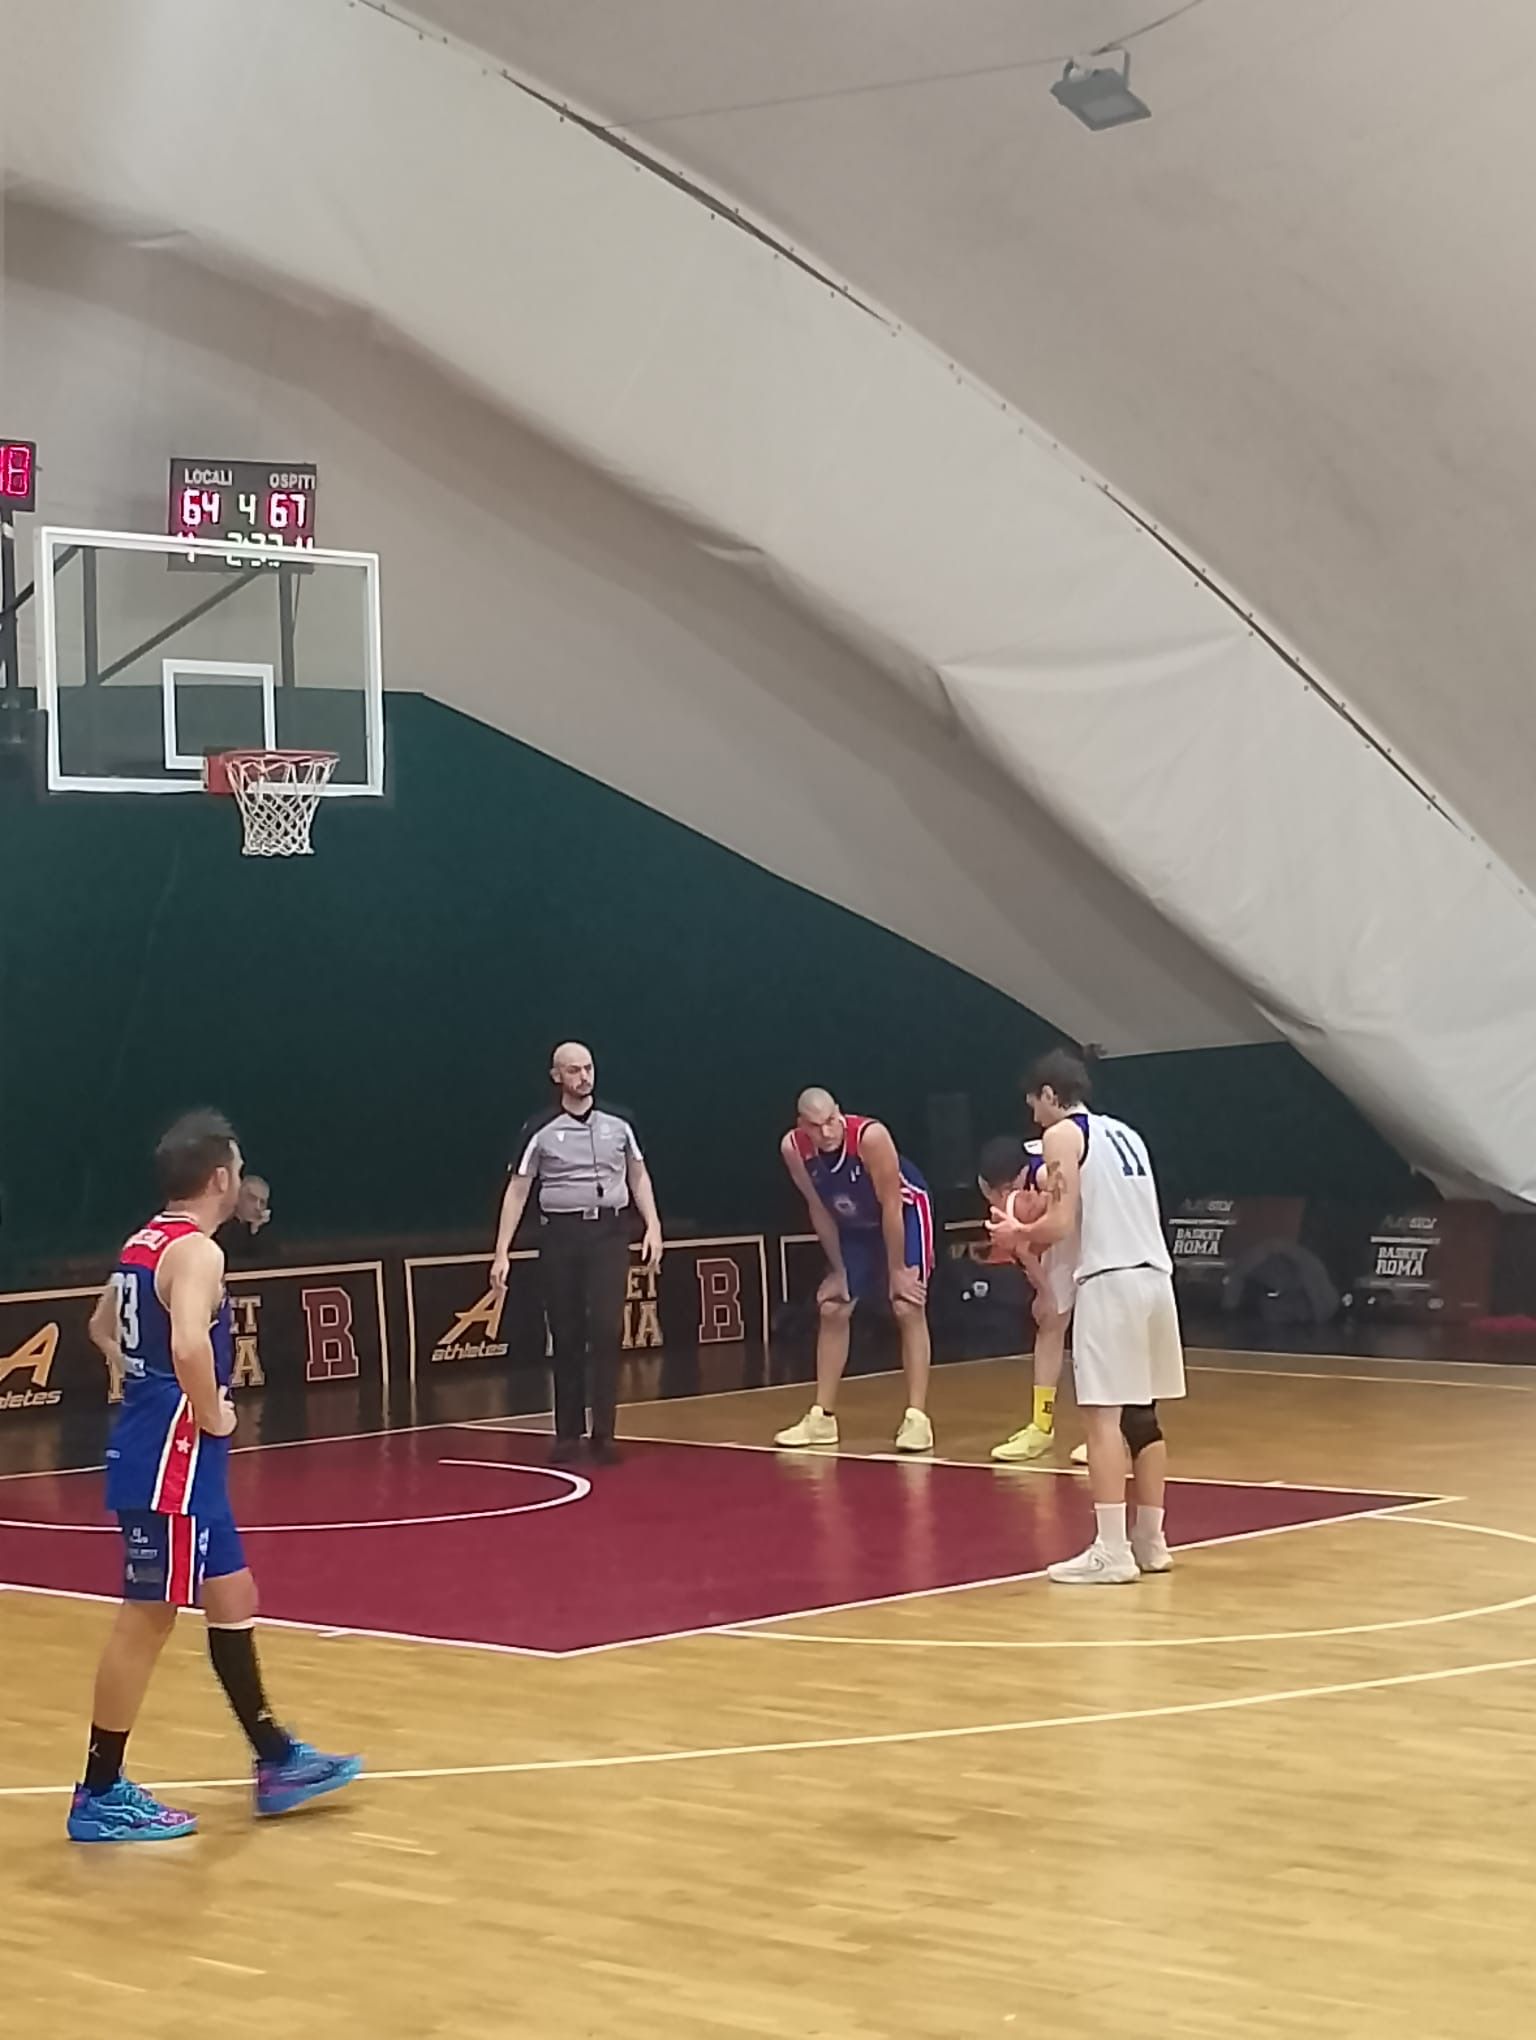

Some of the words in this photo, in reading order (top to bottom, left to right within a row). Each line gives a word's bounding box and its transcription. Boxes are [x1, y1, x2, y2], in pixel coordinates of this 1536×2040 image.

[0, 446, 30, 495] 8
[184, 468, 233, 486] LOCALI
[269, 473, 316, 490] OSPITI
[182, 488, 220, 526] 64
[238, 493, 257, 526] 4
[270, 492, 306, 528] 67
[1105, 1129, 1147, 1177] 11
[1173, 1240, 1219, 1255] ROMA
[1375, 1259, 1424, 1276] ROMA
[697, 1258, 745, 1344] B
[302, 1286, 360, 1382] B
[431, 1341, 509, 1362] athletes
